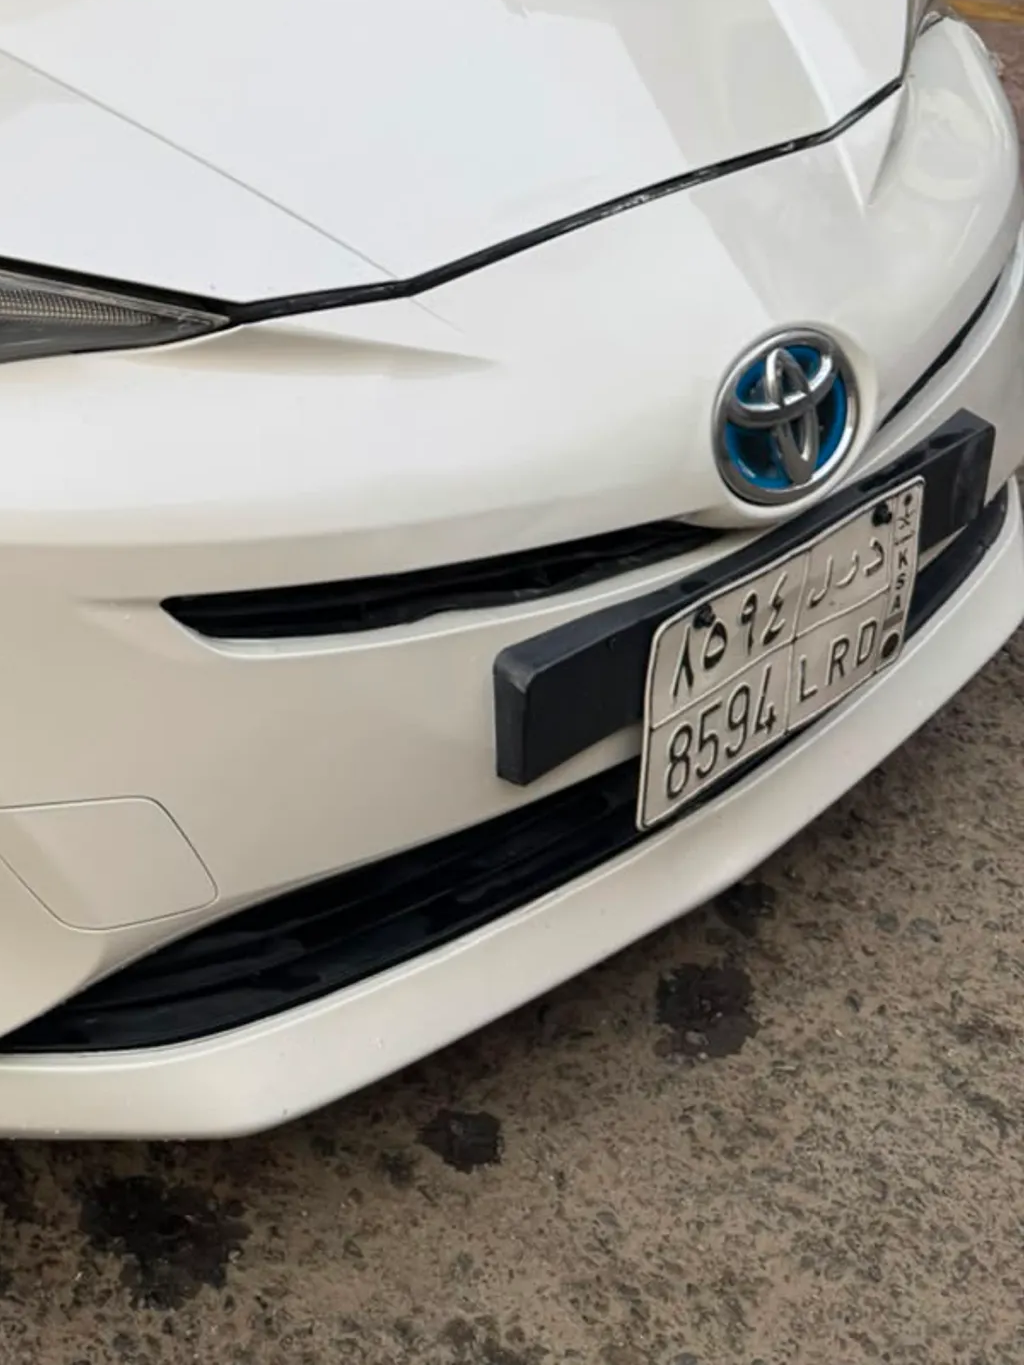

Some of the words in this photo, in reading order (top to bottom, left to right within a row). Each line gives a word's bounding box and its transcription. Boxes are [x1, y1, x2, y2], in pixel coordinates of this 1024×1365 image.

[889, 548, 909, 615] KSA
[665, 662, 778, 801] 8594
[796, 615, 878, 704] LRD
